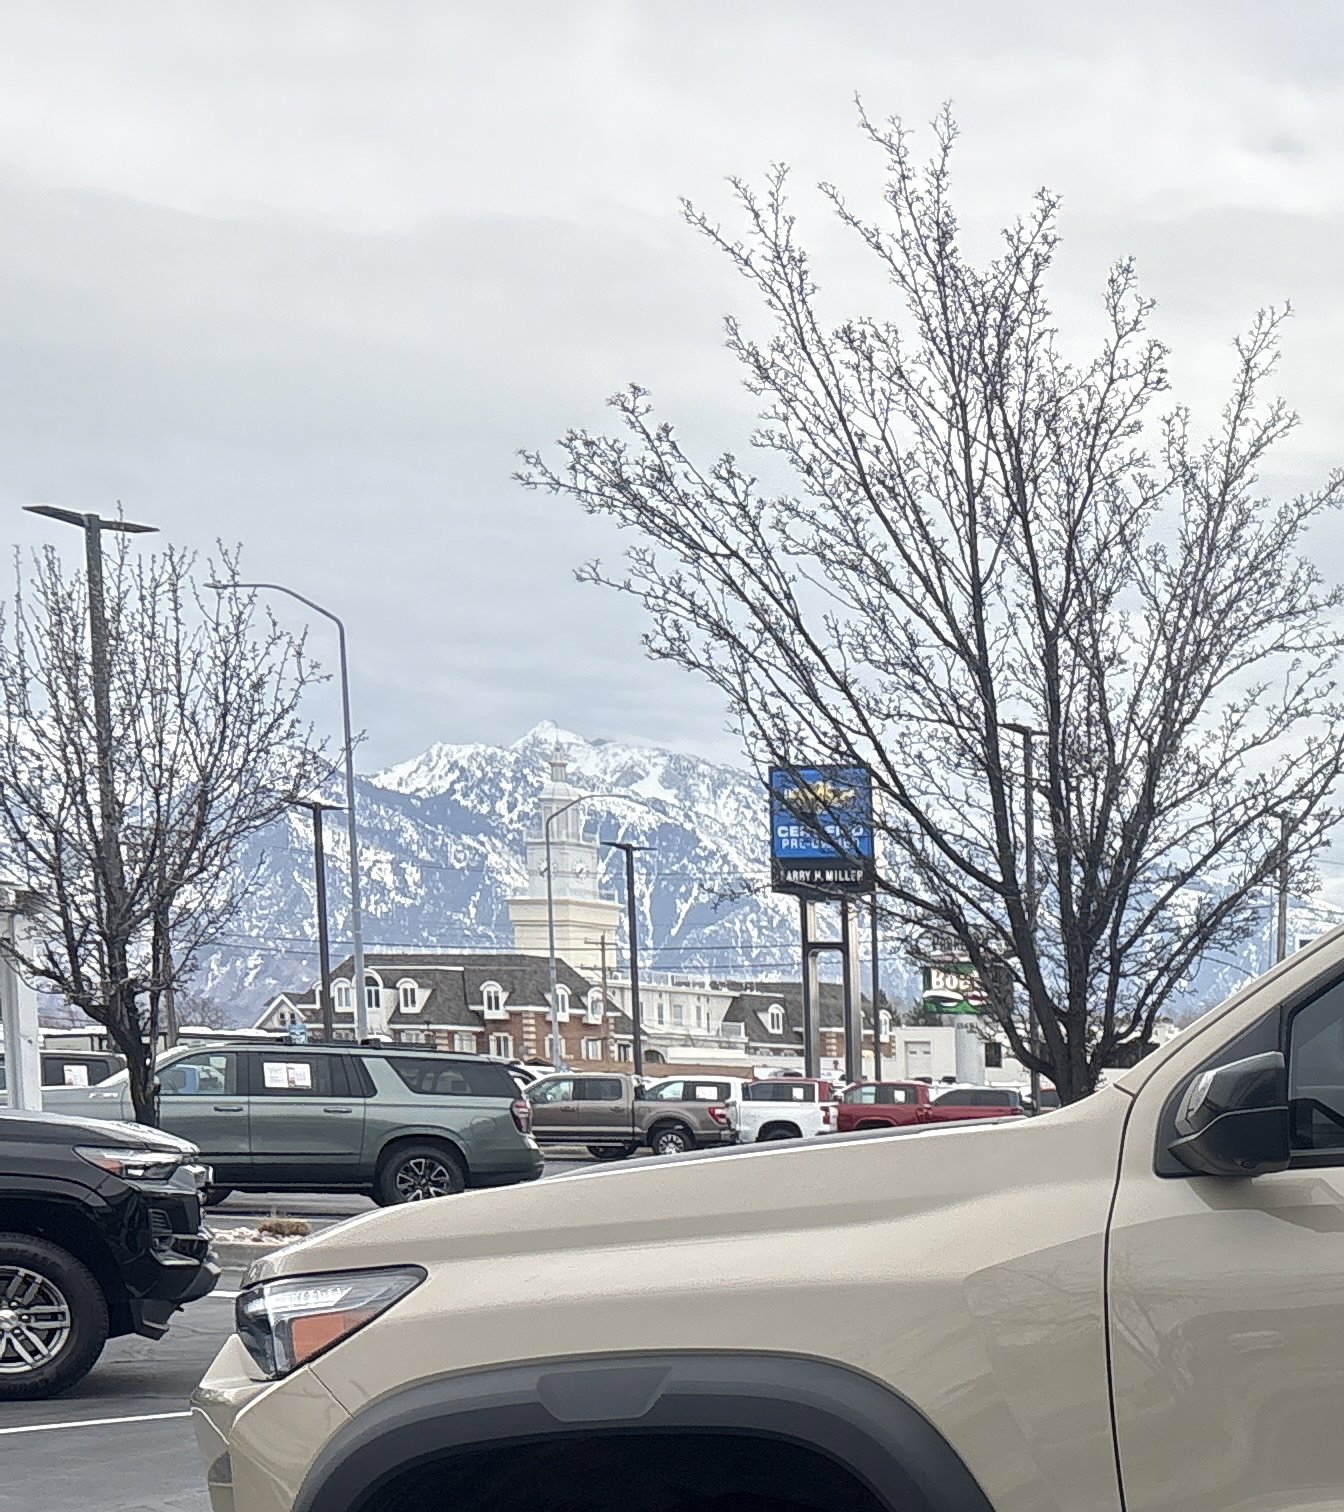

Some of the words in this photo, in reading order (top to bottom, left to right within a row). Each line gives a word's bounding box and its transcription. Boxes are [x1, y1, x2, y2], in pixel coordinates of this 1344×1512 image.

[777, 825, 864, 838] CERFID
[779, 869, 811, 882] ARRY
[826, 869, 864, 882] MILLER
